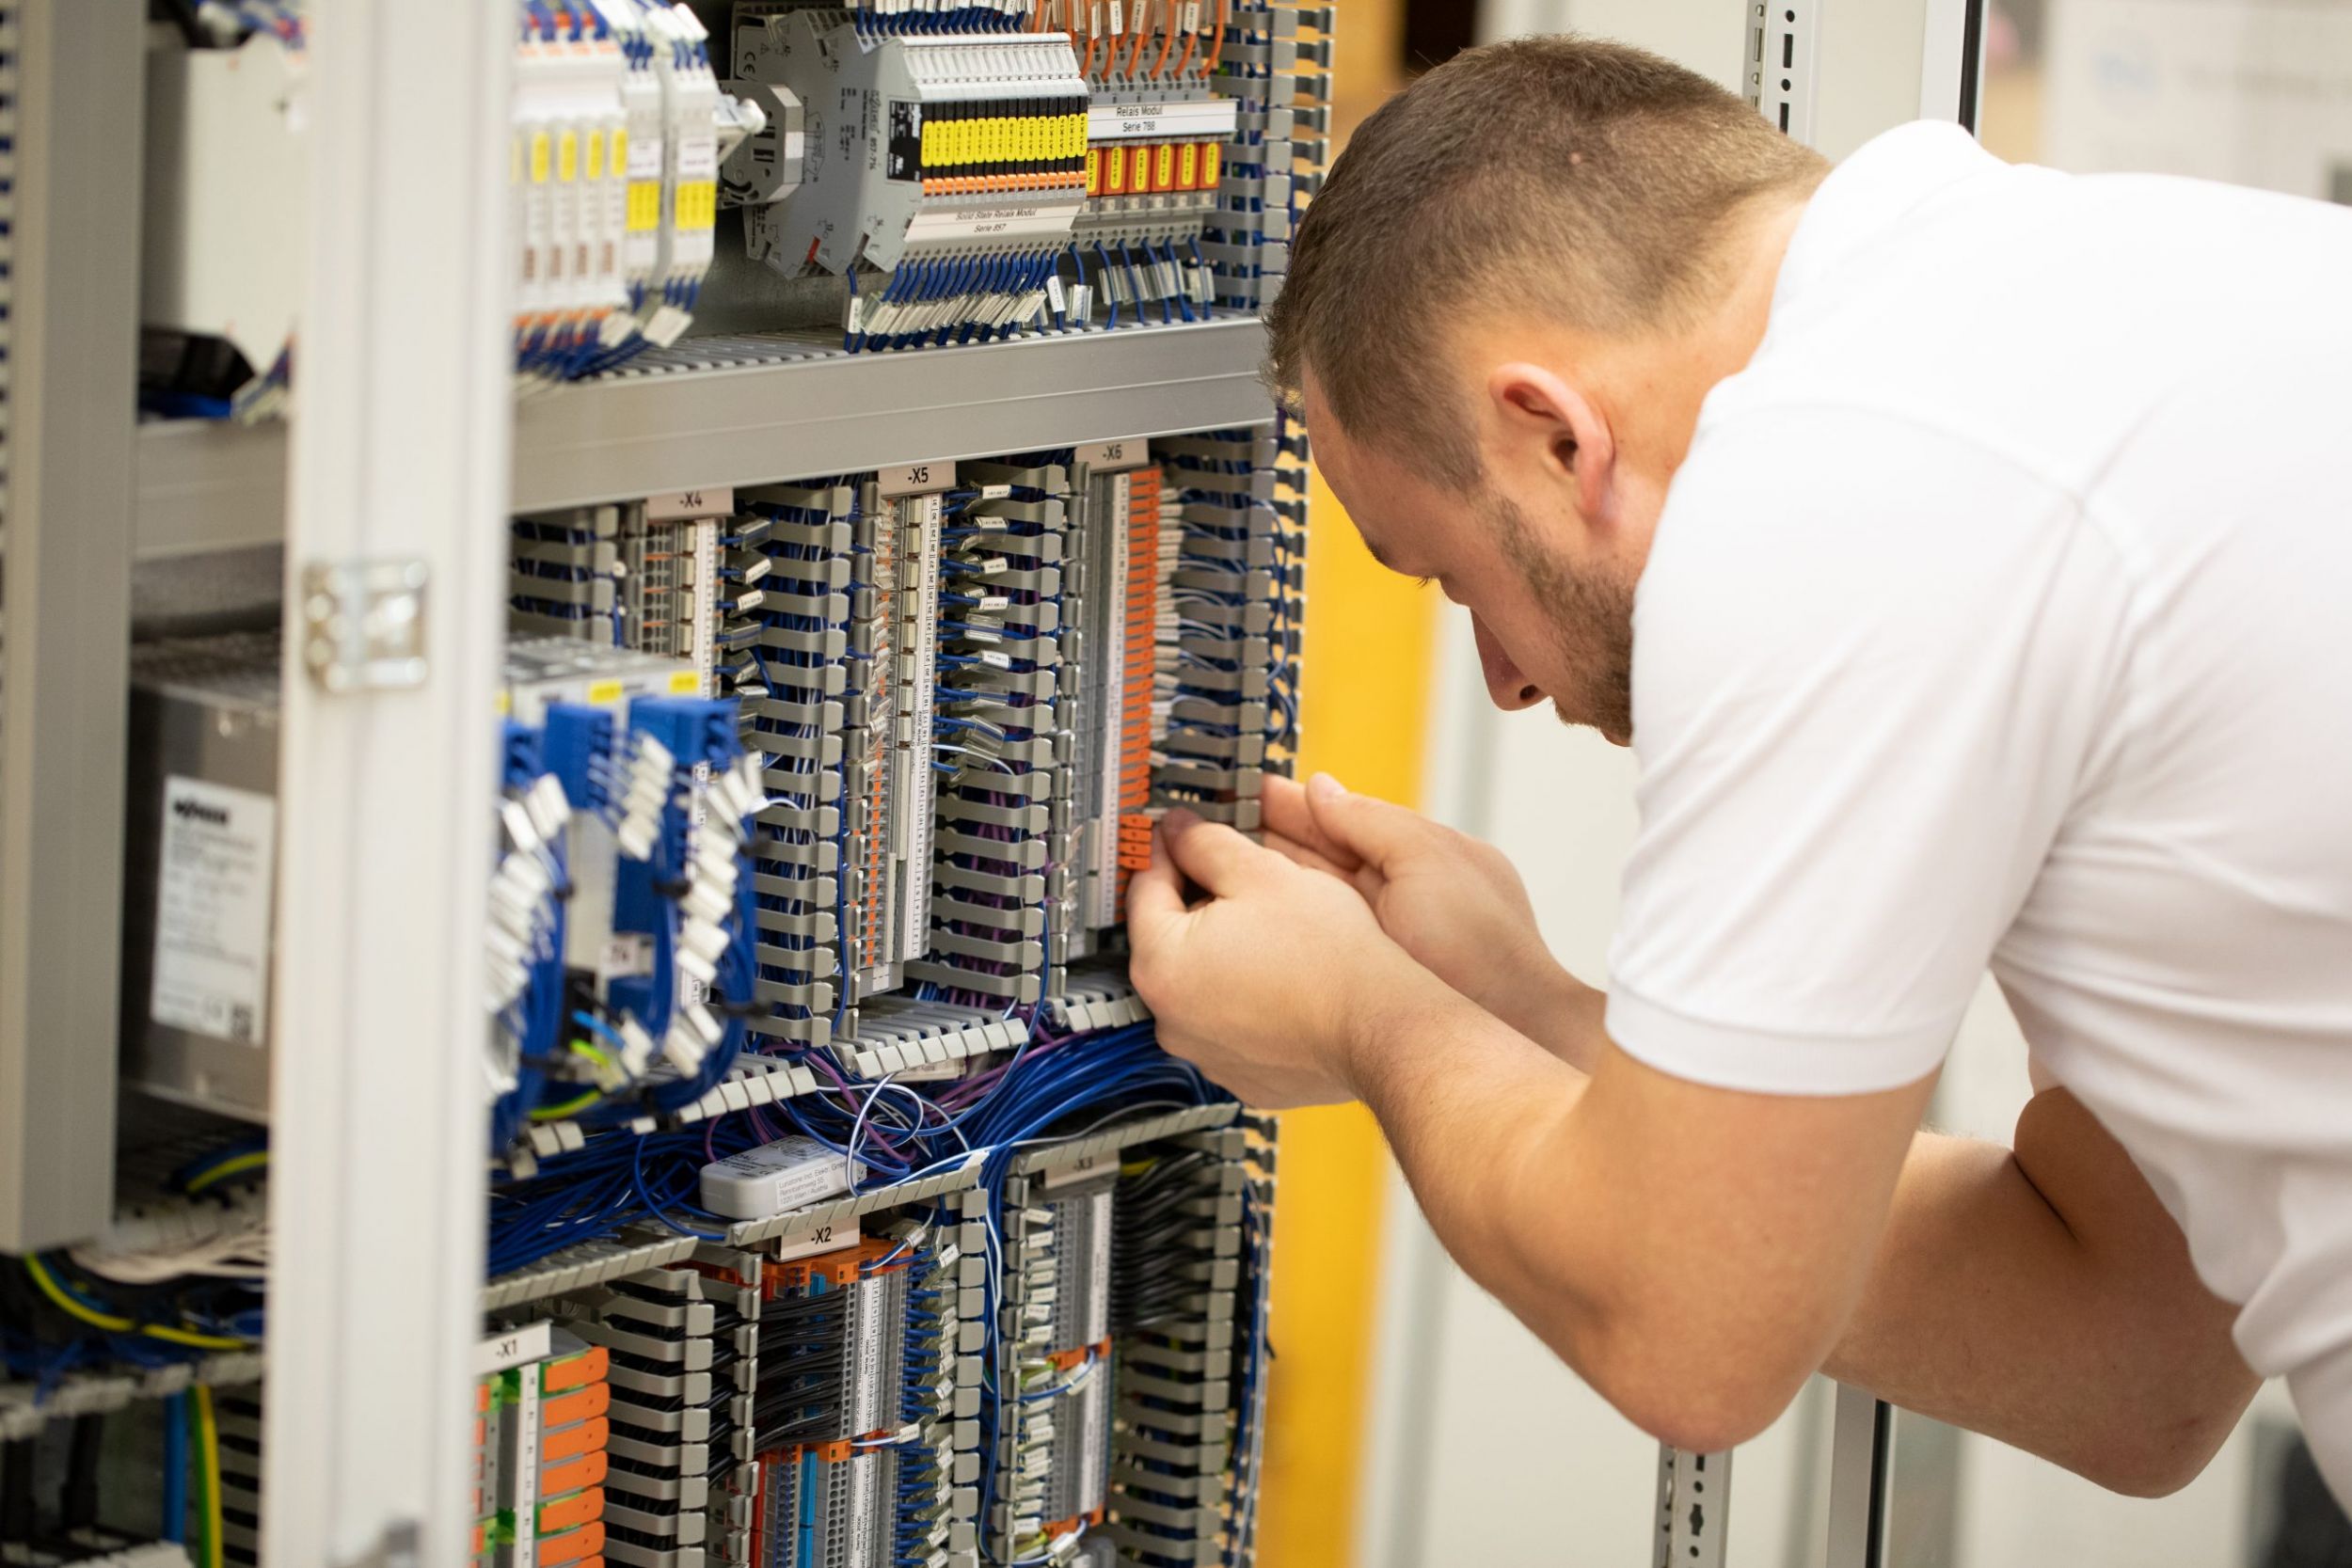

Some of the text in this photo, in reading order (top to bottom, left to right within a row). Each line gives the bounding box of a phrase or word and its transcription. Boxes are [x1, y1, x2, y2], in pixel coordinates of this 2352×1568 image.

[1117, 105, 1163, 117] Relais Modul
[1123, 122, 1140, 132] Serie
[974, 224, 992, 233] Serie
[1103, 444, 1122, 460] -X6
[908, 467, 929, 485] -X5
[679, 493, 702, 508] -X4
[1073, 1156, 1093, 1172] -X3
[811, 1185, 828, 1197] Austria
[811, 1227, 832, 1245] -X2
[496, 1340, 518, 1358] -X1
